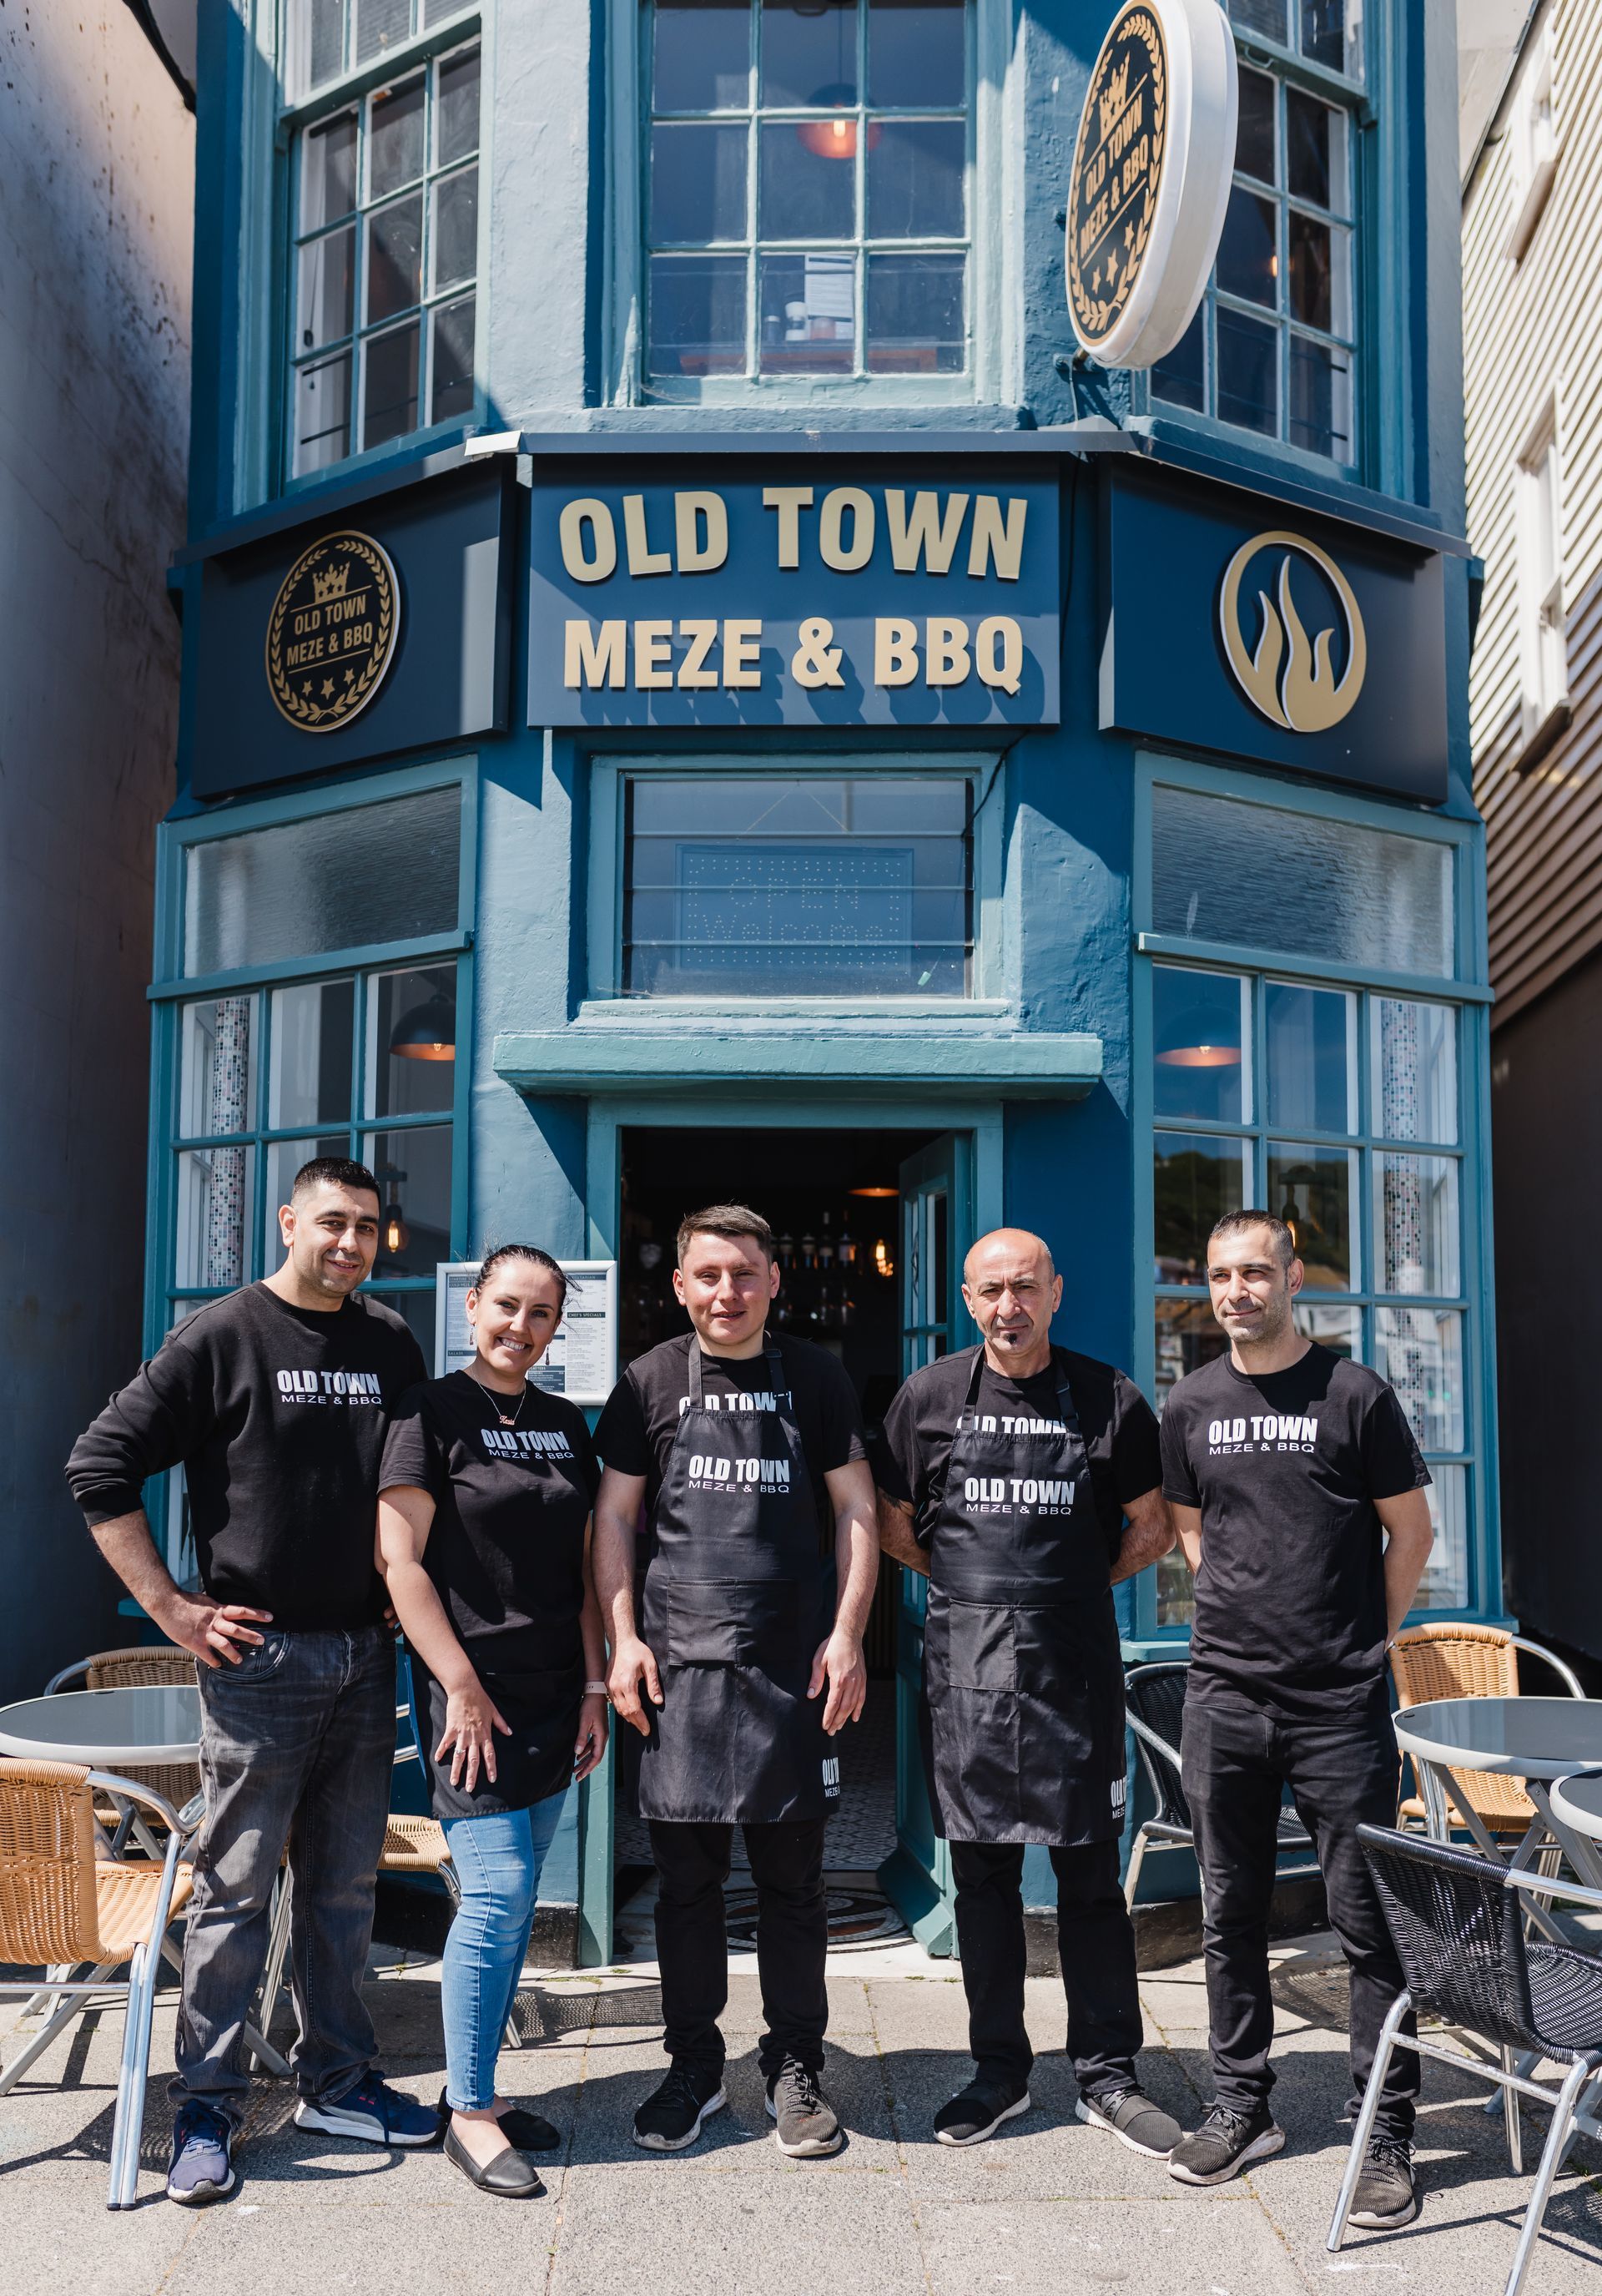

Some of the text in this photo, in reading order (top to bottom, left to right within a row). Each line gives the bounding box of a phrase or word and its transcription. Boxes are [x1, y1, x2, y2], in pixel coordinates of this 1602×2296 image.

[1086, 92, 1142, 204] OLD TOWN
[1081, 133, 1149, 259] MEZE & BBQ
[559, 486, 1028, 583] OLD TOWN
[295, 593, 367, 636] OLD TOWN
[286, 621, 374, 668] MEZE & BBQ
[563, 615, 1023, 695] MEZE & BBQ
[729, 876, 859, 910] OPEN
[702, 914, 883, 947] Welcome
[277, 1370, 381, 1395] OLD TOWN
[281, 1395, 382, 1405] MEZE & BBQ
[678, 1391, 793, 1417] OD TOW
[481, 1428, 570, 1451] OLD TOWN
[1209, 1415, 1318, 1445] OLD TOWN
[489, 1448, 530, 1460] MEZE
[547, 1451, 575, 1460] BBQ
[1209, 1442, 1315, 1455] MEZE & BBQ
[688, 1455, 790, 1483] OLD TOWN
[688, 1480, 789, 1493] MEZE & BBQ
[965, 1477, 1076, 1505] OLD TOWN
[966, 1503, 1071, 1516] MEZE & BBQ
